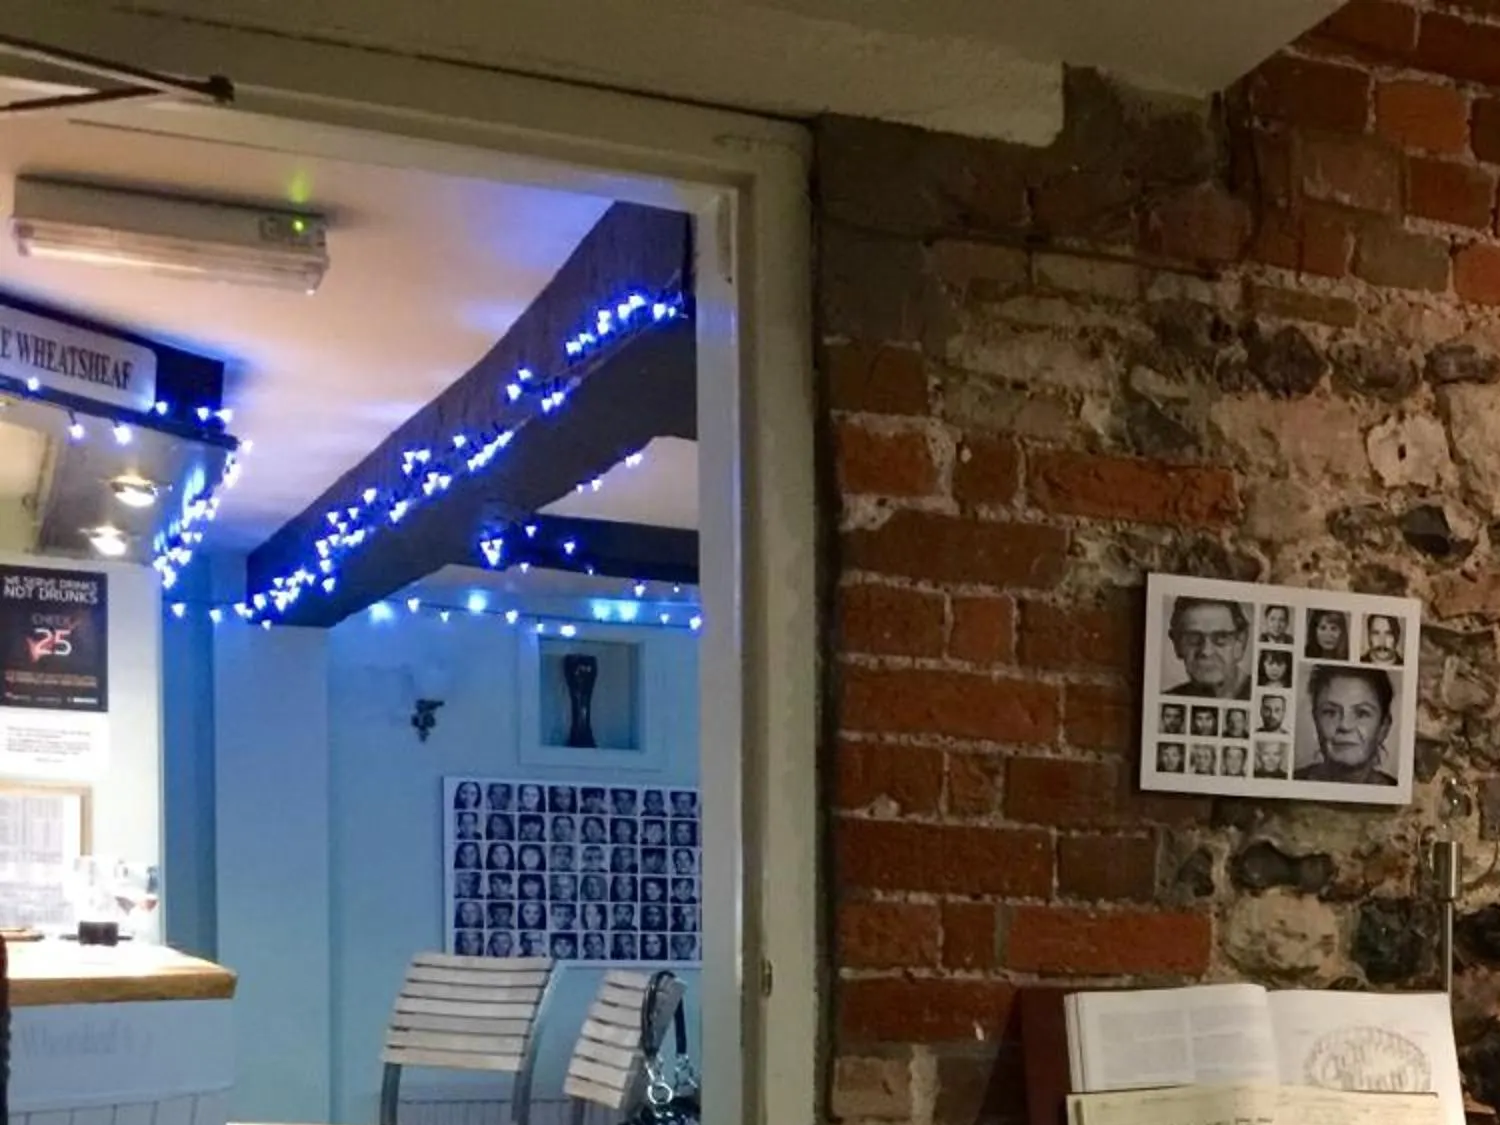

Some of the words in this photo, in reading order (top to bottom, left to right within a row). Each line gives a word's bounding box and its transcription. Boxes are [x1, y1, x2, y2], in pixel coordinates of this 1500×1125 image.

[16, 331, 133, 391] WHEATSHEAF
[4, 584, 33, 598] NOT
[40, 587, 98, 605] DRUNKS
[60, 579, 98, 593] DRINKS
[35, 628, 72, 656] 25
